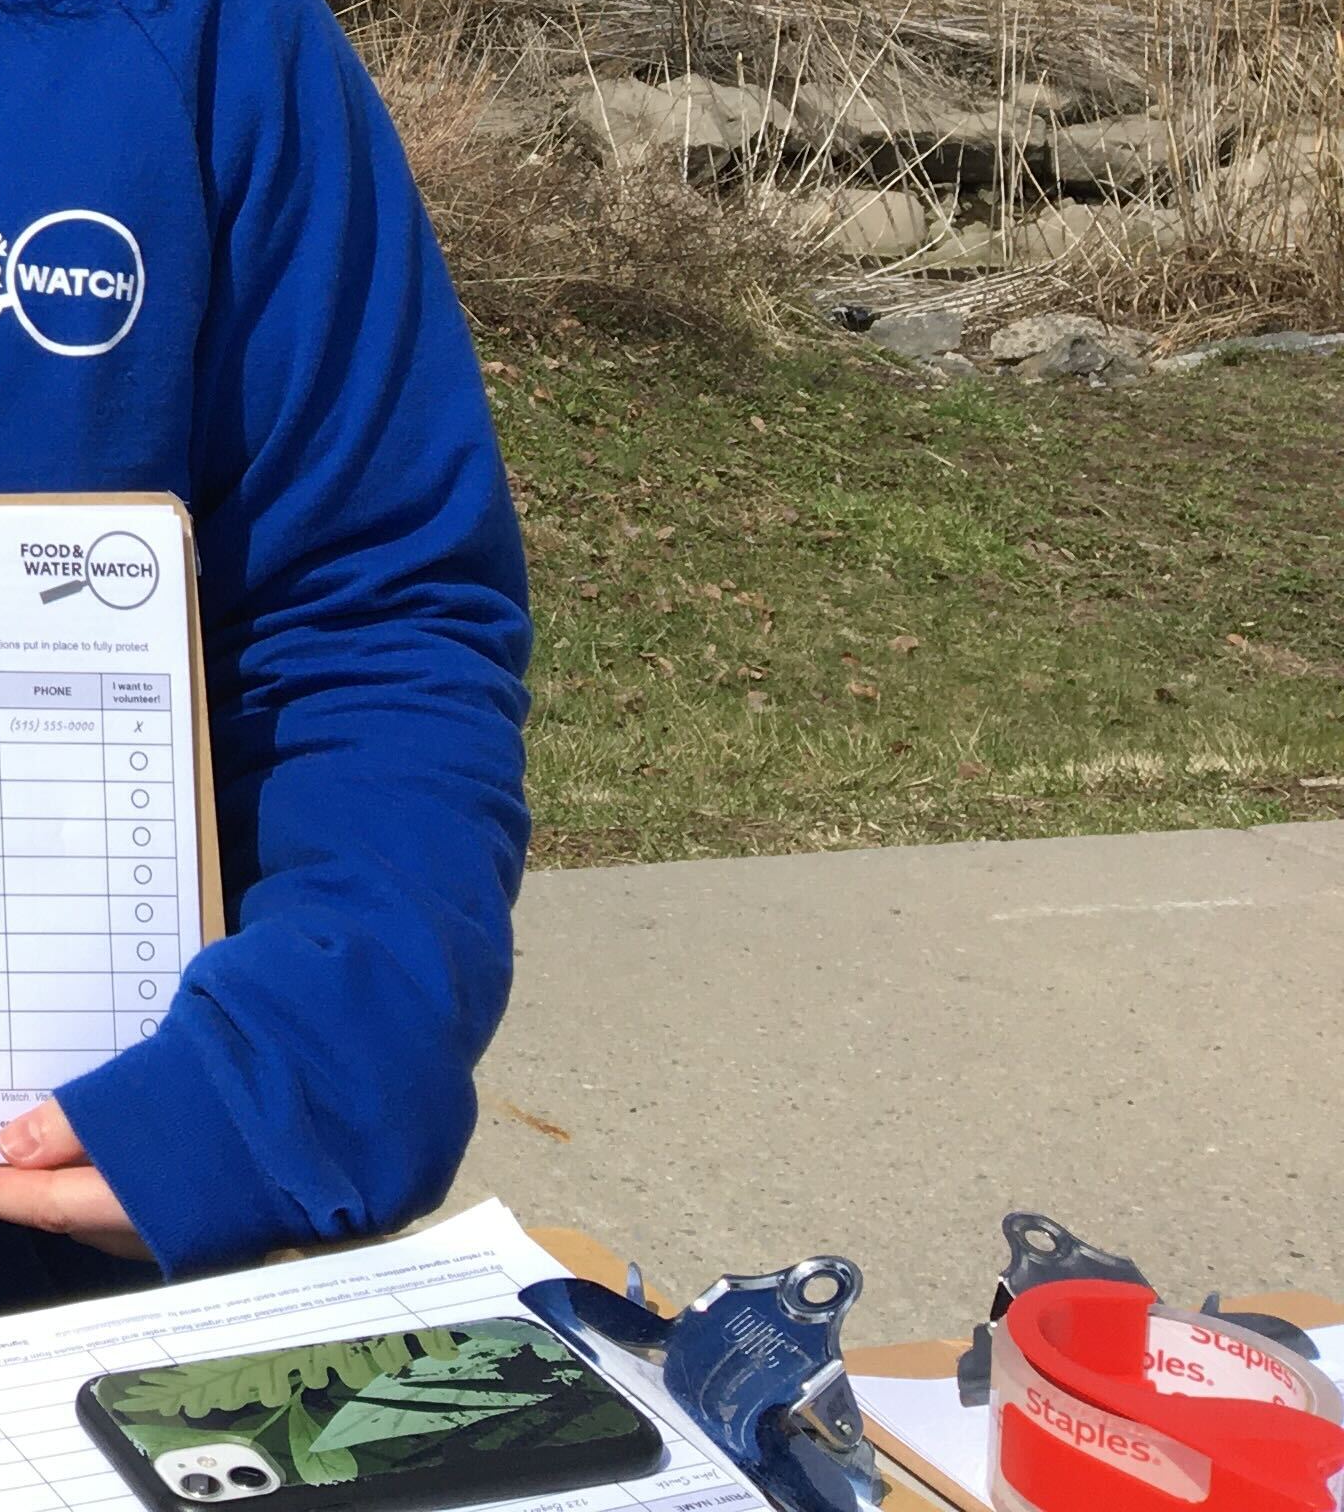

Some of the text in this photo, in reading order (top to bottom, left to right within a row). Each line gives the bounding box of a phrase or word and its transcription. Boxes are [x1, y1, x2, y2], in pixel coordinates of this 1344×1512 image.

[17, 263, 135, 302] WATCH
[24, 561, 153, 578] WATER WATCH
[22, 640, 38, 651] put
[40, 640, 50, 649] in
[52, 640, 78, 652] place
[80, 641, 91, 650] to
[92, 641, 112, 652] fully
[115, 641, 148, 653] protect
[33, 685, 73, 696] PHONE
[112, 681, 153, 691] I want to
[113, 694, 161, 704] volunteer!
[43, 719, 95, 732] 555-0000
[673, 1491, 753, 1512] PRINT NAME
